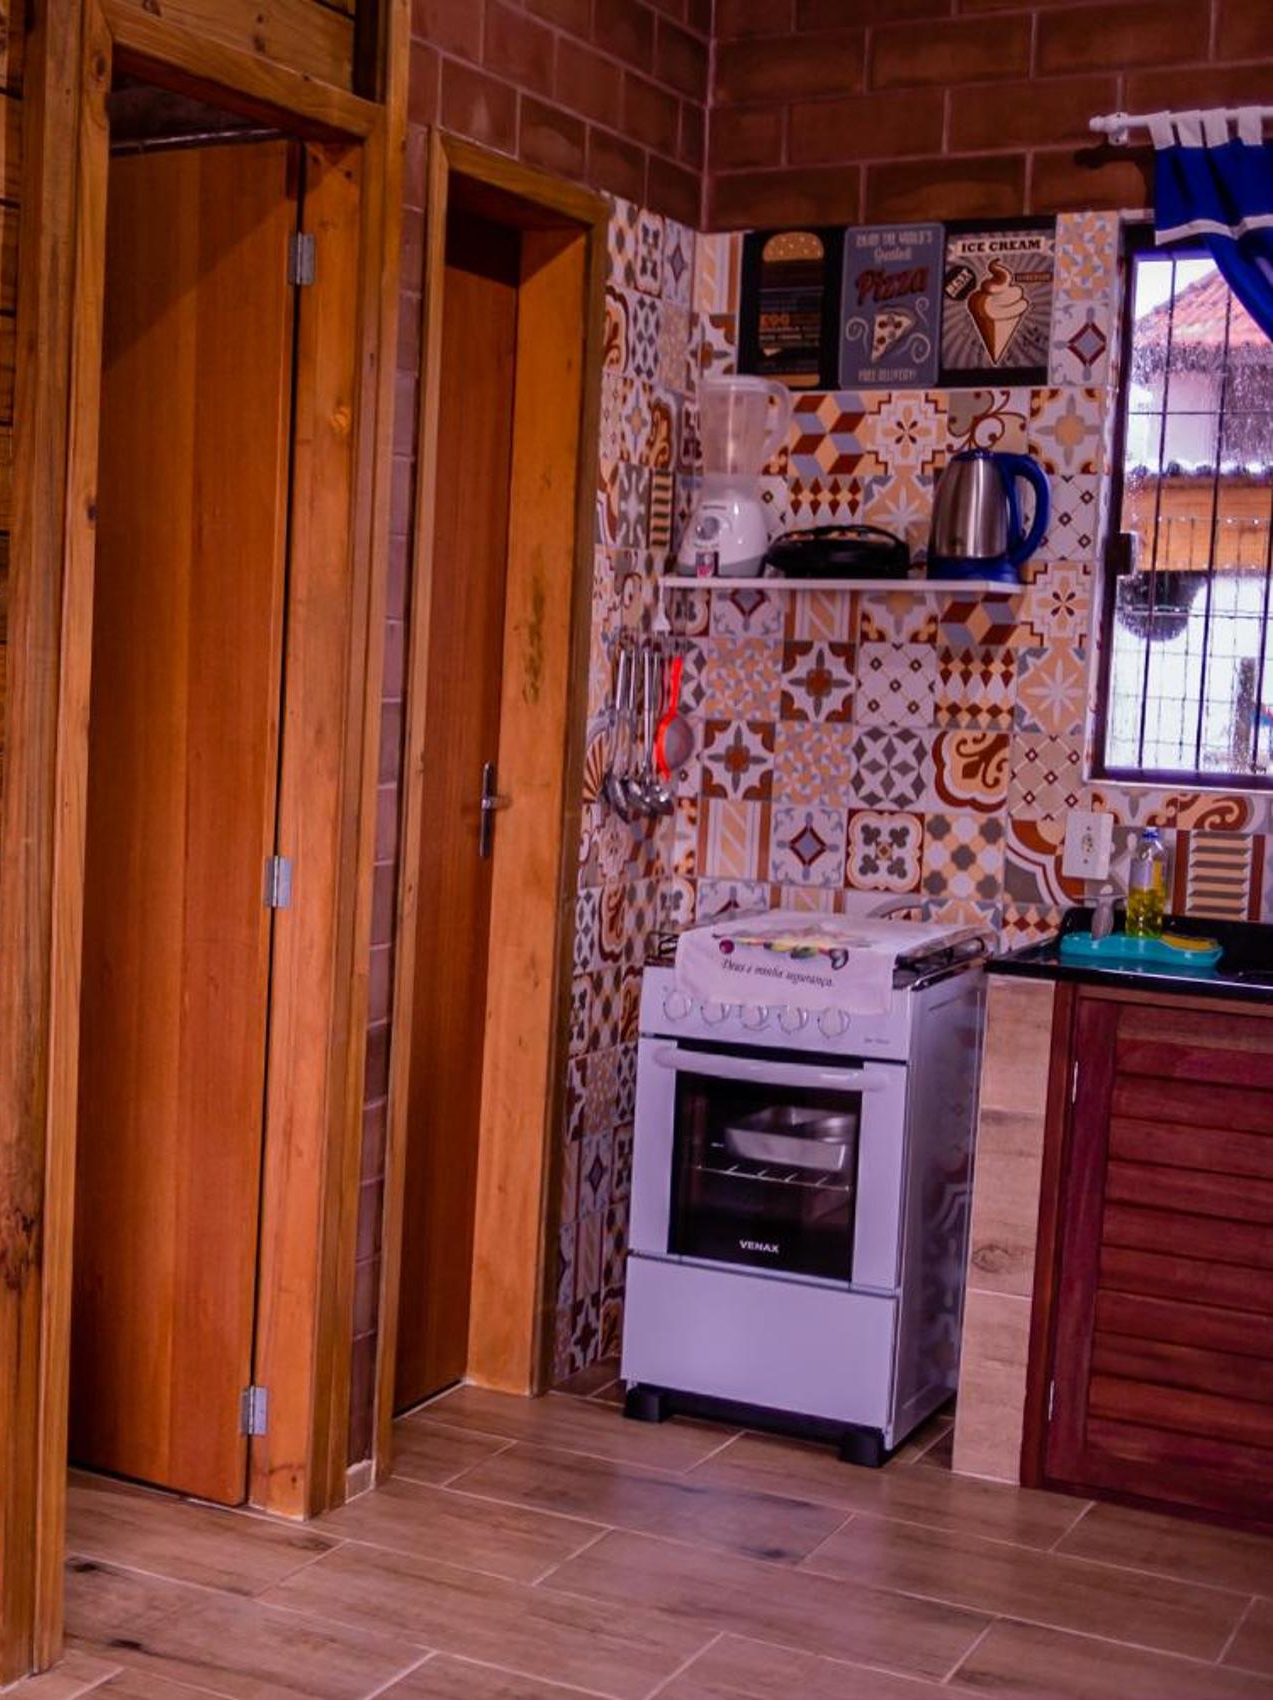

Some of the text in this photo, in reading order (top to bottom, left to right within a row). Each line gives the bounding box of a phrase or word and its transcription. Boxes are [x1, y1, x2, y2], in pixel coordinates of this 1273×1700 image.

[961, 239, 1041, 253] ICE CREAM
[855, 266, 929, 304] Pizza
[739, 1239, 780, 1254] VENAX
